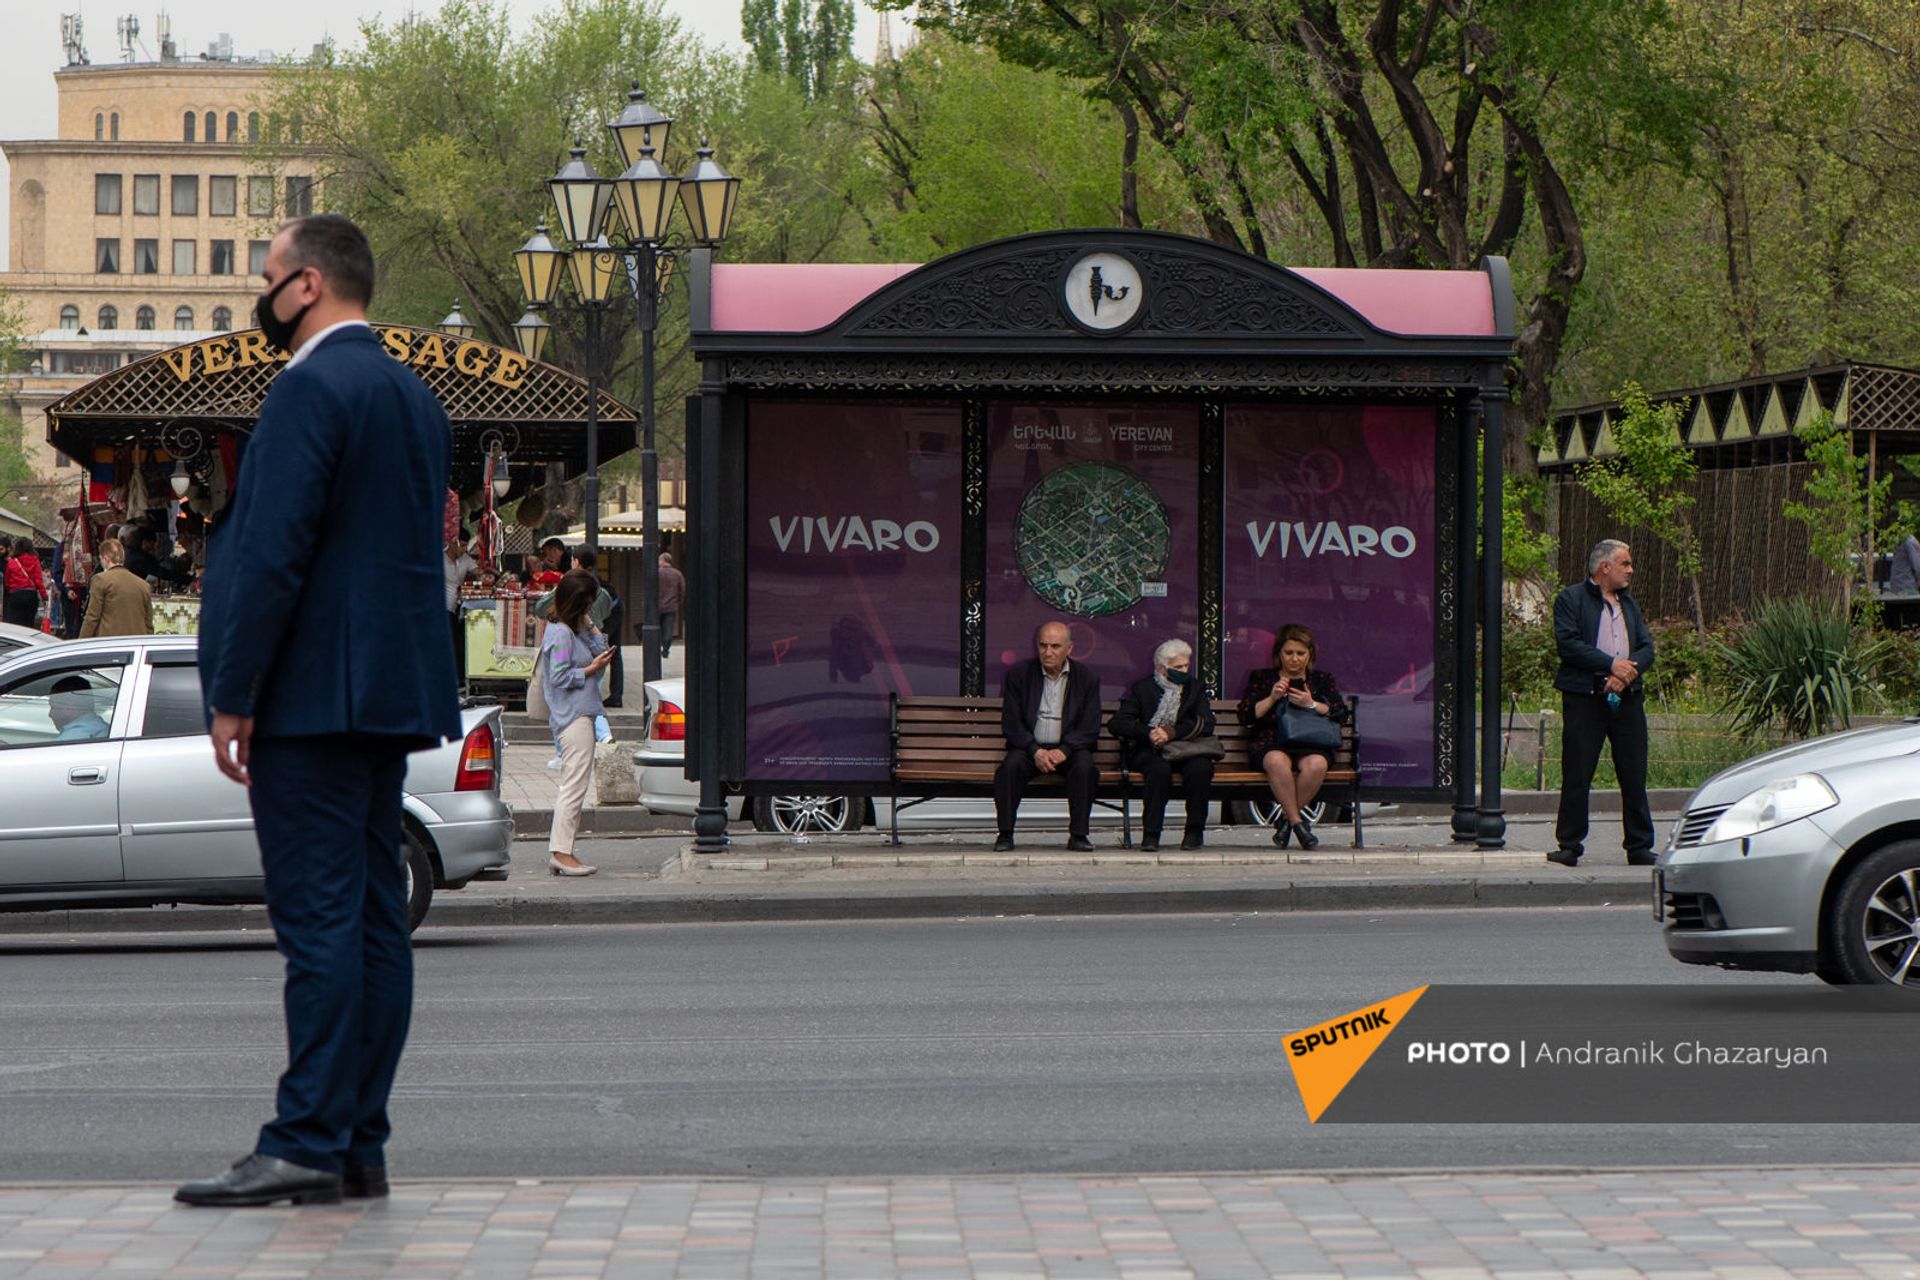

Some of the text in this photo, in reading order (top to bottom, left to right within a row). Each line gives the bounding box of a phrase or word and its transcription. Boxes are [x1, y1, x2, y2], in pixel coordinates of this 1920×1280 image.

[161, 327, 528, 390] VERSAGE
[1014, 424, 1076, 441] ԵՐԵՎԱՆ
[1109, 427, 1173, 441] YEREVAN
[769, 516, 939, 553] VIVARO
[1246, 521, 1416, 558] VIVARO
